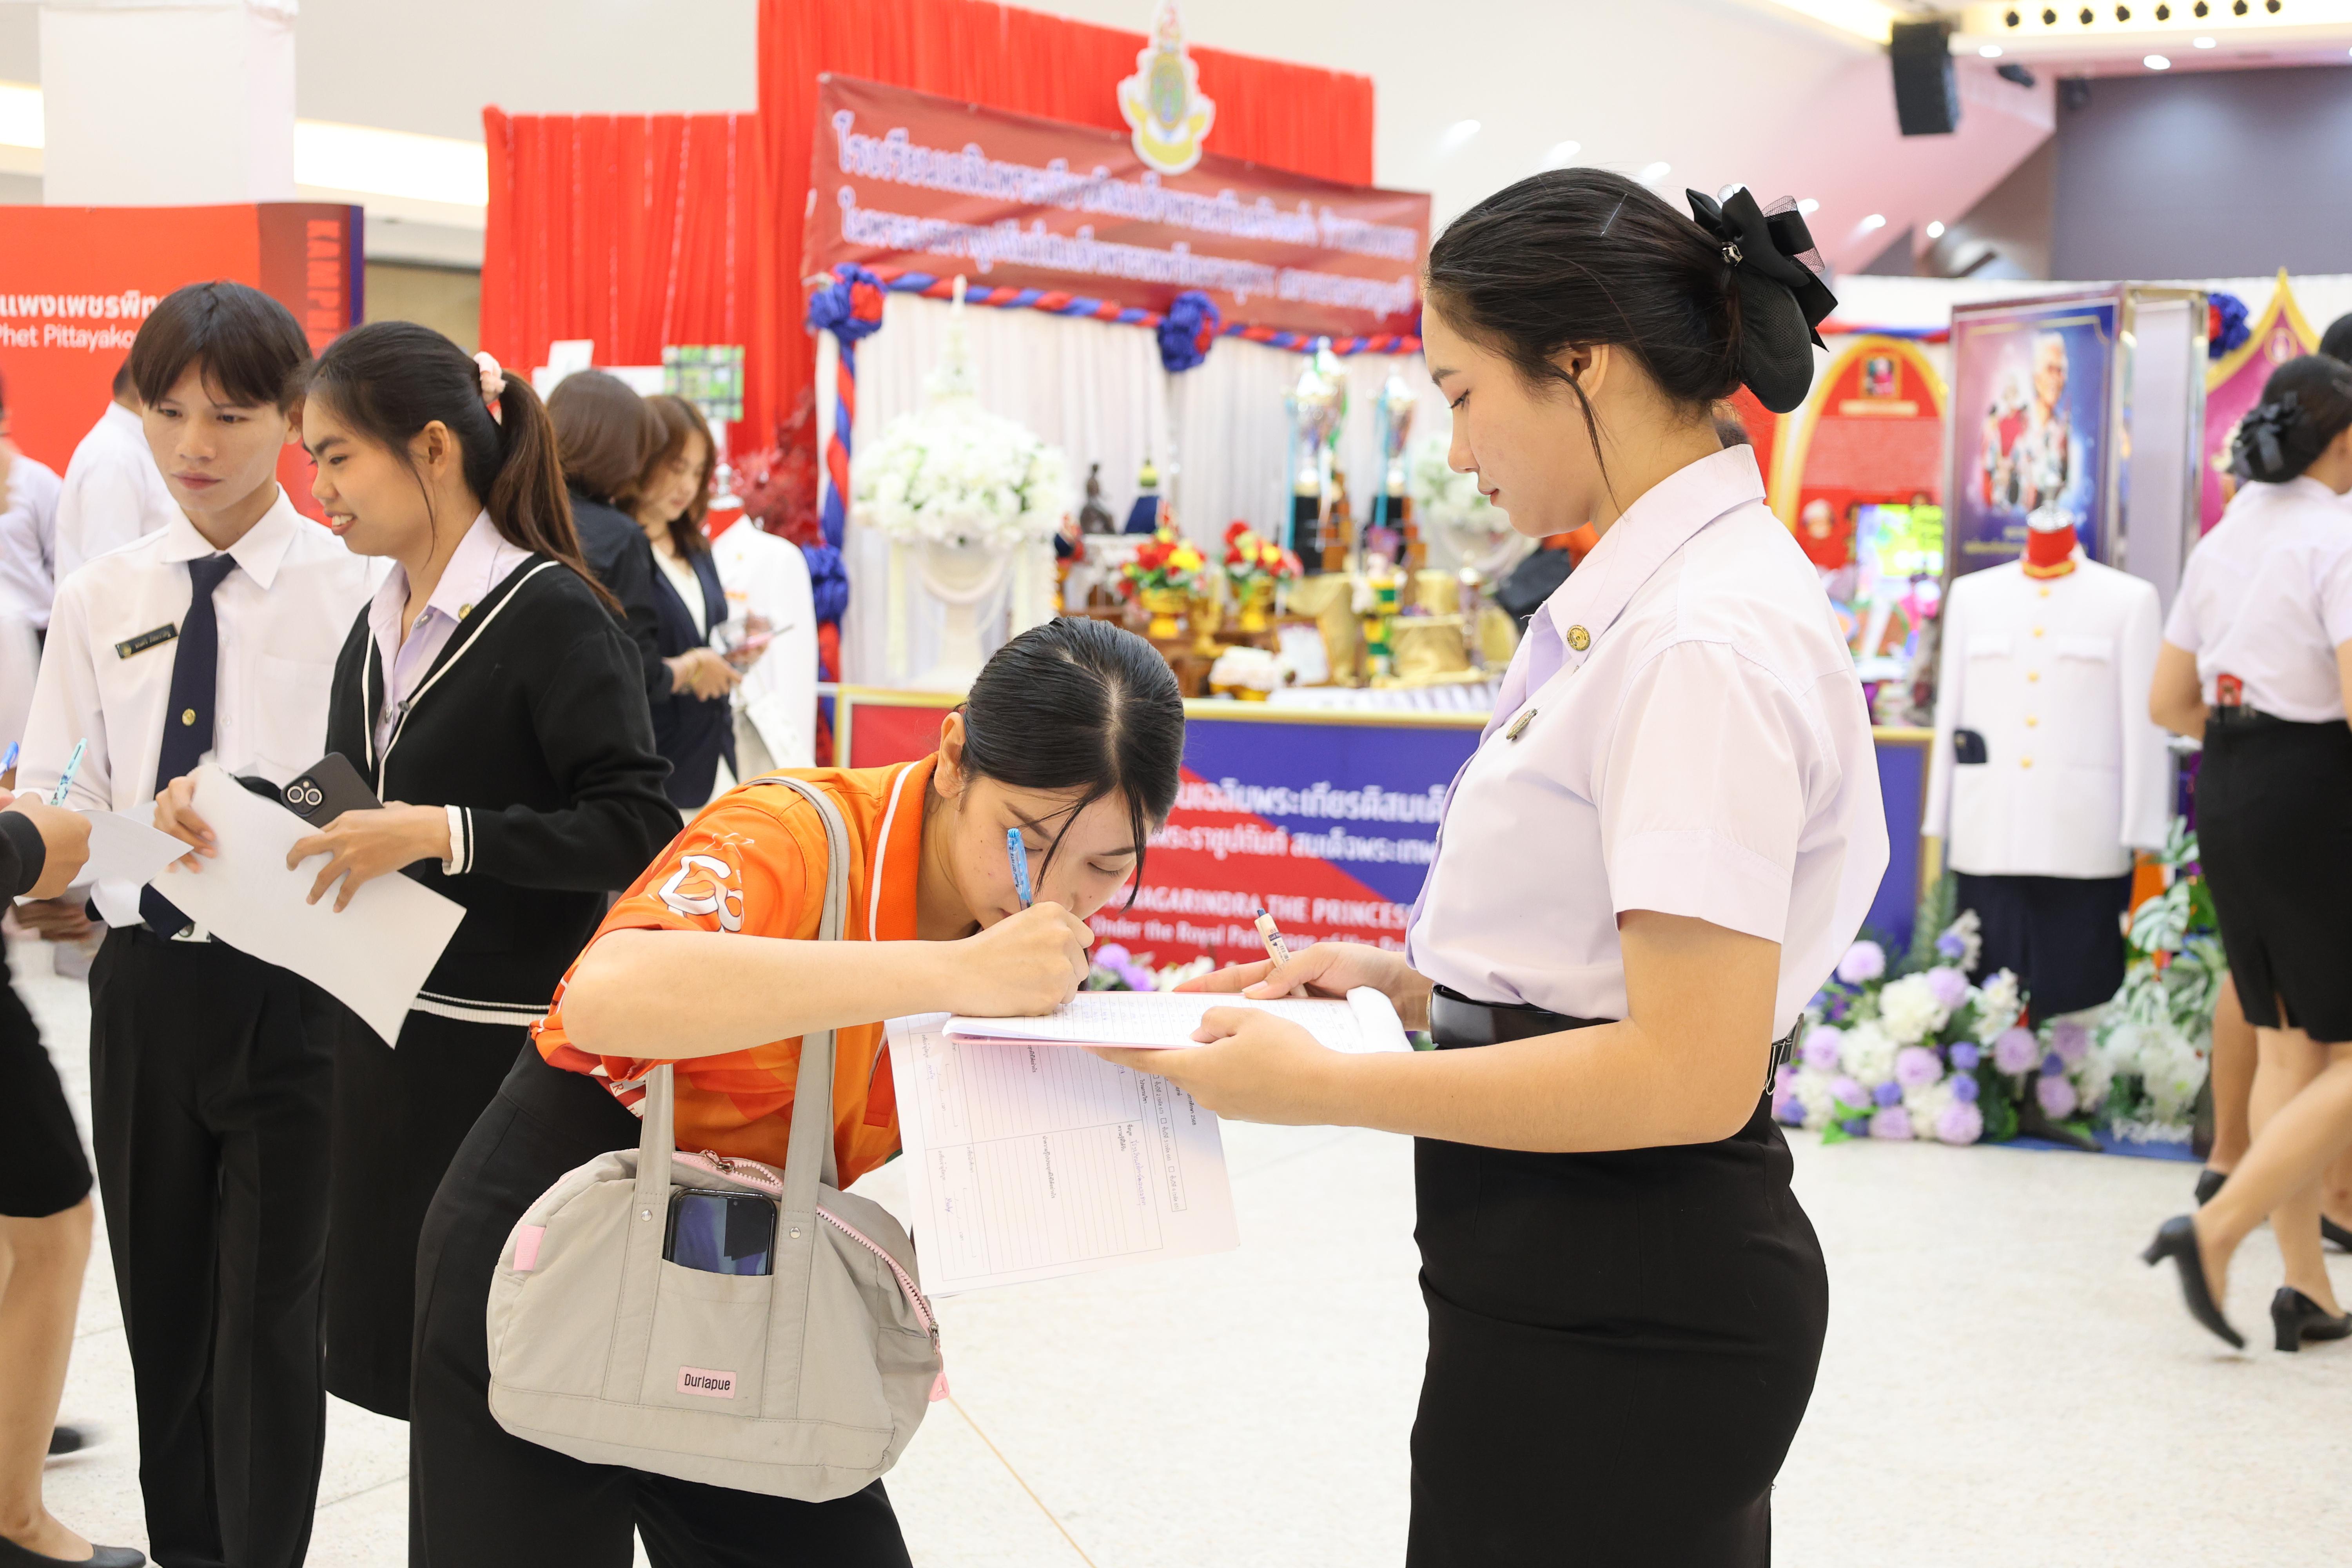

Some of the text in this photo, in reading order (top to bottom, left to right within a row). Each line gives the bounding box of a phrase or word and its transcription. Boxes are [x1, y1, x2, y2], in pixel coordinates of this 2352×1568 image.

[0, 289, 163, 320] แพงเพชรพิท
[684, 1373, 731, 1391] Durlapue
